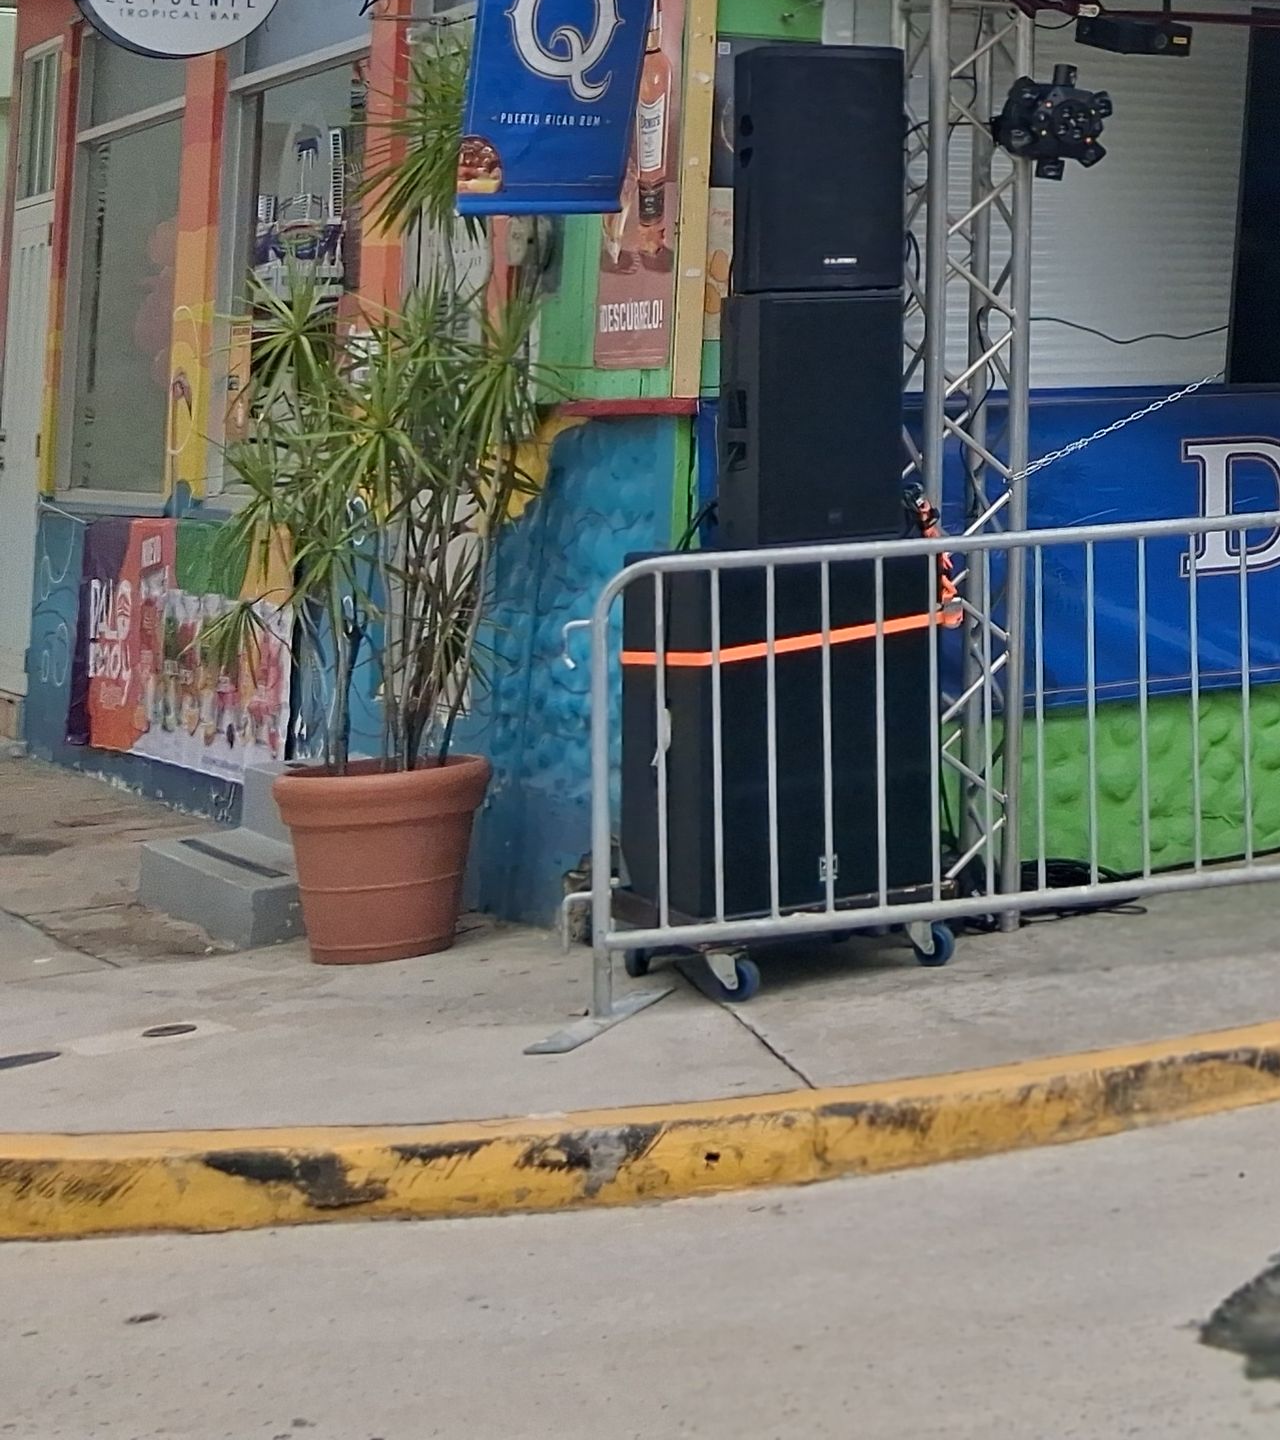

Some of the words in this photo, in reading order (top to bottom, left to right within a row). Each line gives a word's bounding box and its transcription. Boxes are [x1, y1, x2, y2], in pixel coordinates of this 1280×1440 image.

[119, 8, 199, 21] TROPICAL
[210, 11, 241, 22] BAR
[499, 112, 541, 127] PUERTO
[545, 113, 576, 128] RICAN
[579, 115, 602, 128] RUM
